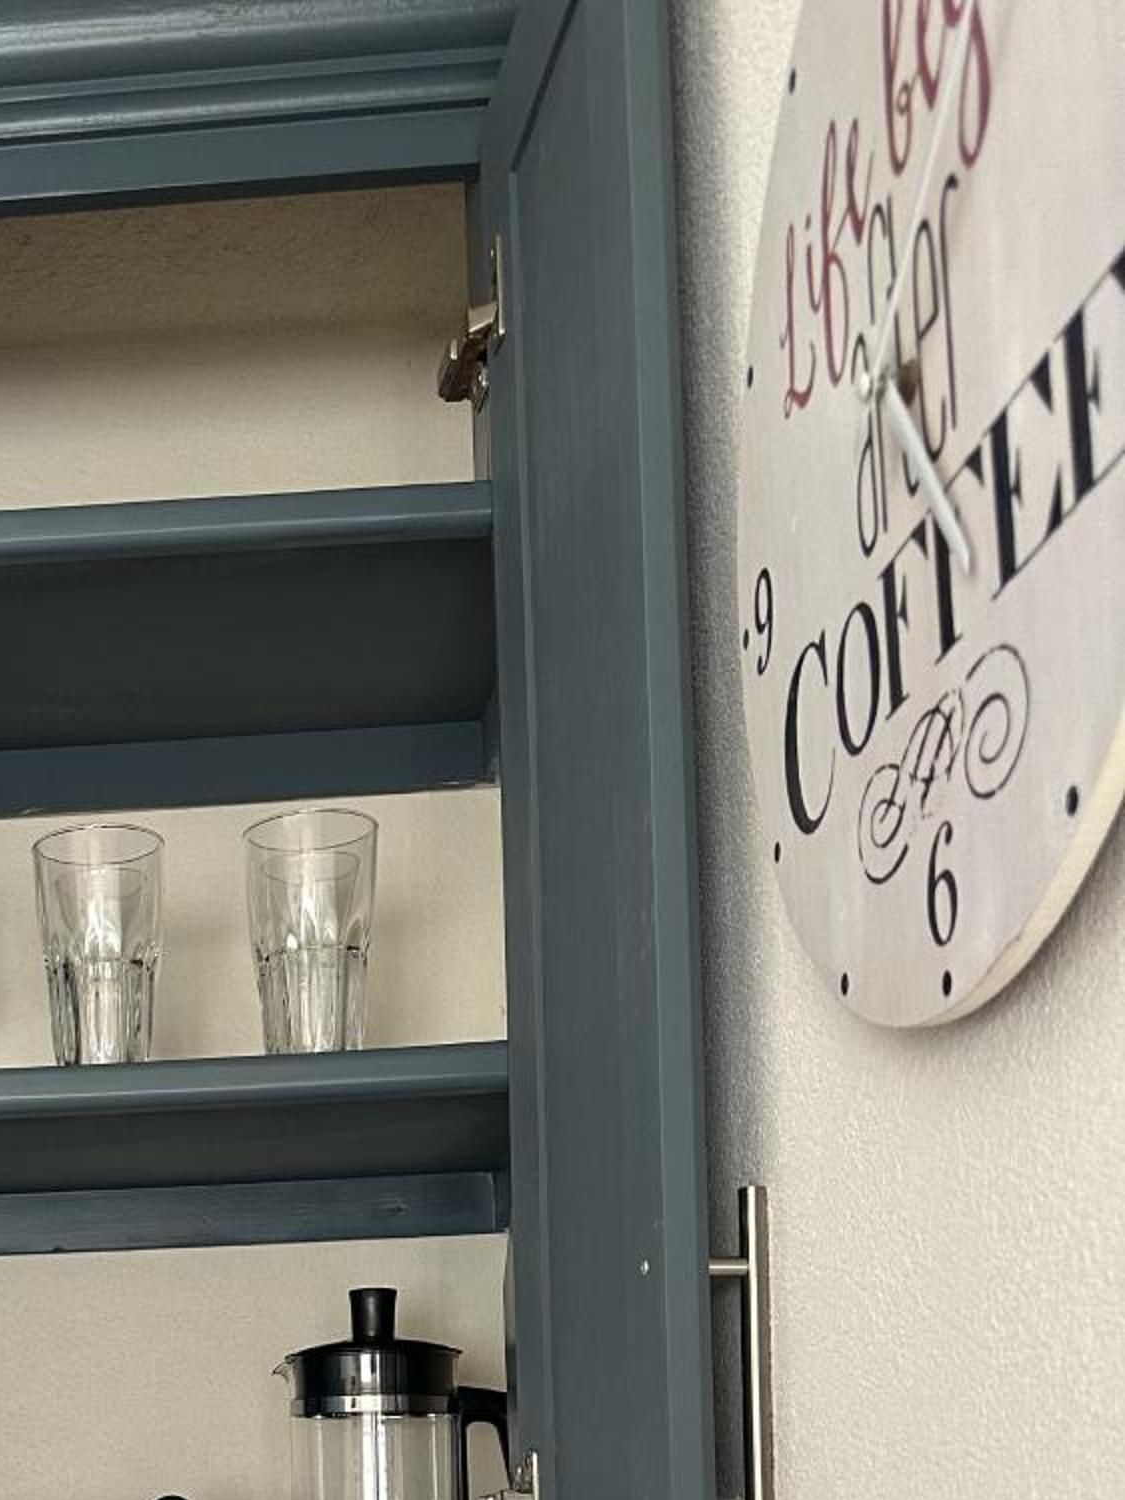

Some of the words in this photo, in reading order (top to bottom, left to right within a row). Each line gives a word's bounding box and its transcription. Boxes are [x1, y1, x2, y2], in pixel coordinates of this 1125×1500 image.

[779, 117, 874, 419] Life
[851, 173, 959, 558] after
[754, 567, 774, 676] 9
[783, 244, 1125, 837] COFFEE
[925, 819, 959, 947] 6
